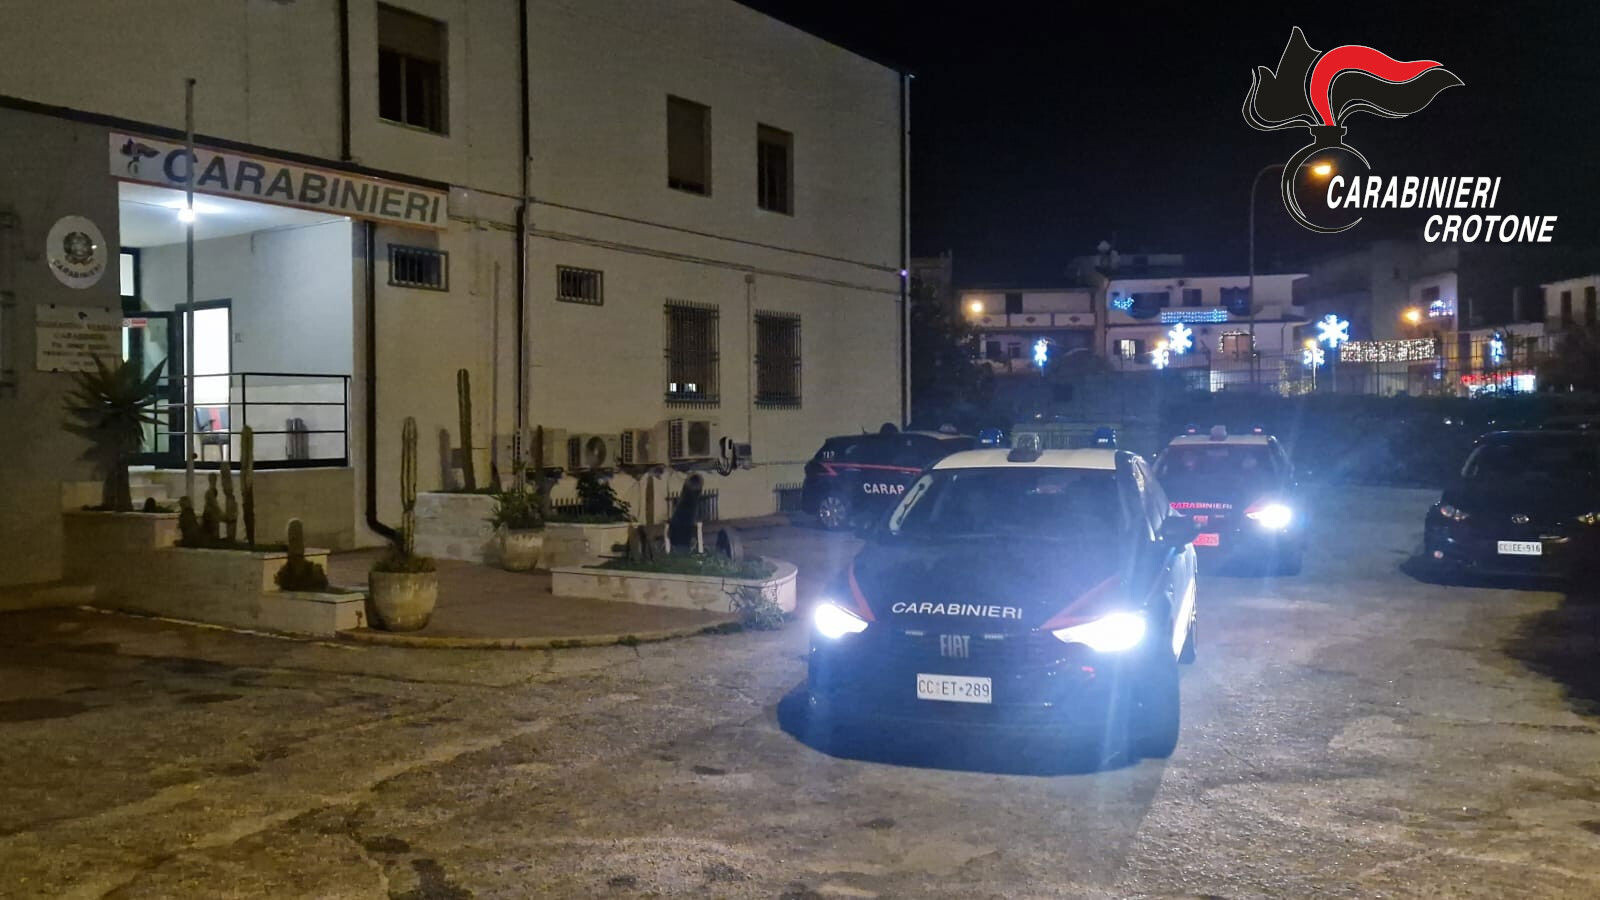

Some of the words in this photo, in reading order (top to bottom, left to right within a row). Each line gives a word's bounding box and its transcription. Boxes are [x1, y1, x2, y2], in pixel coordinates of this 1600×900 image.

[163, 149, 438, 223] CARABINIERI
[891, 601, 1023, 620] CARABINIERI
[940, 634, 970, 658] FIAT
